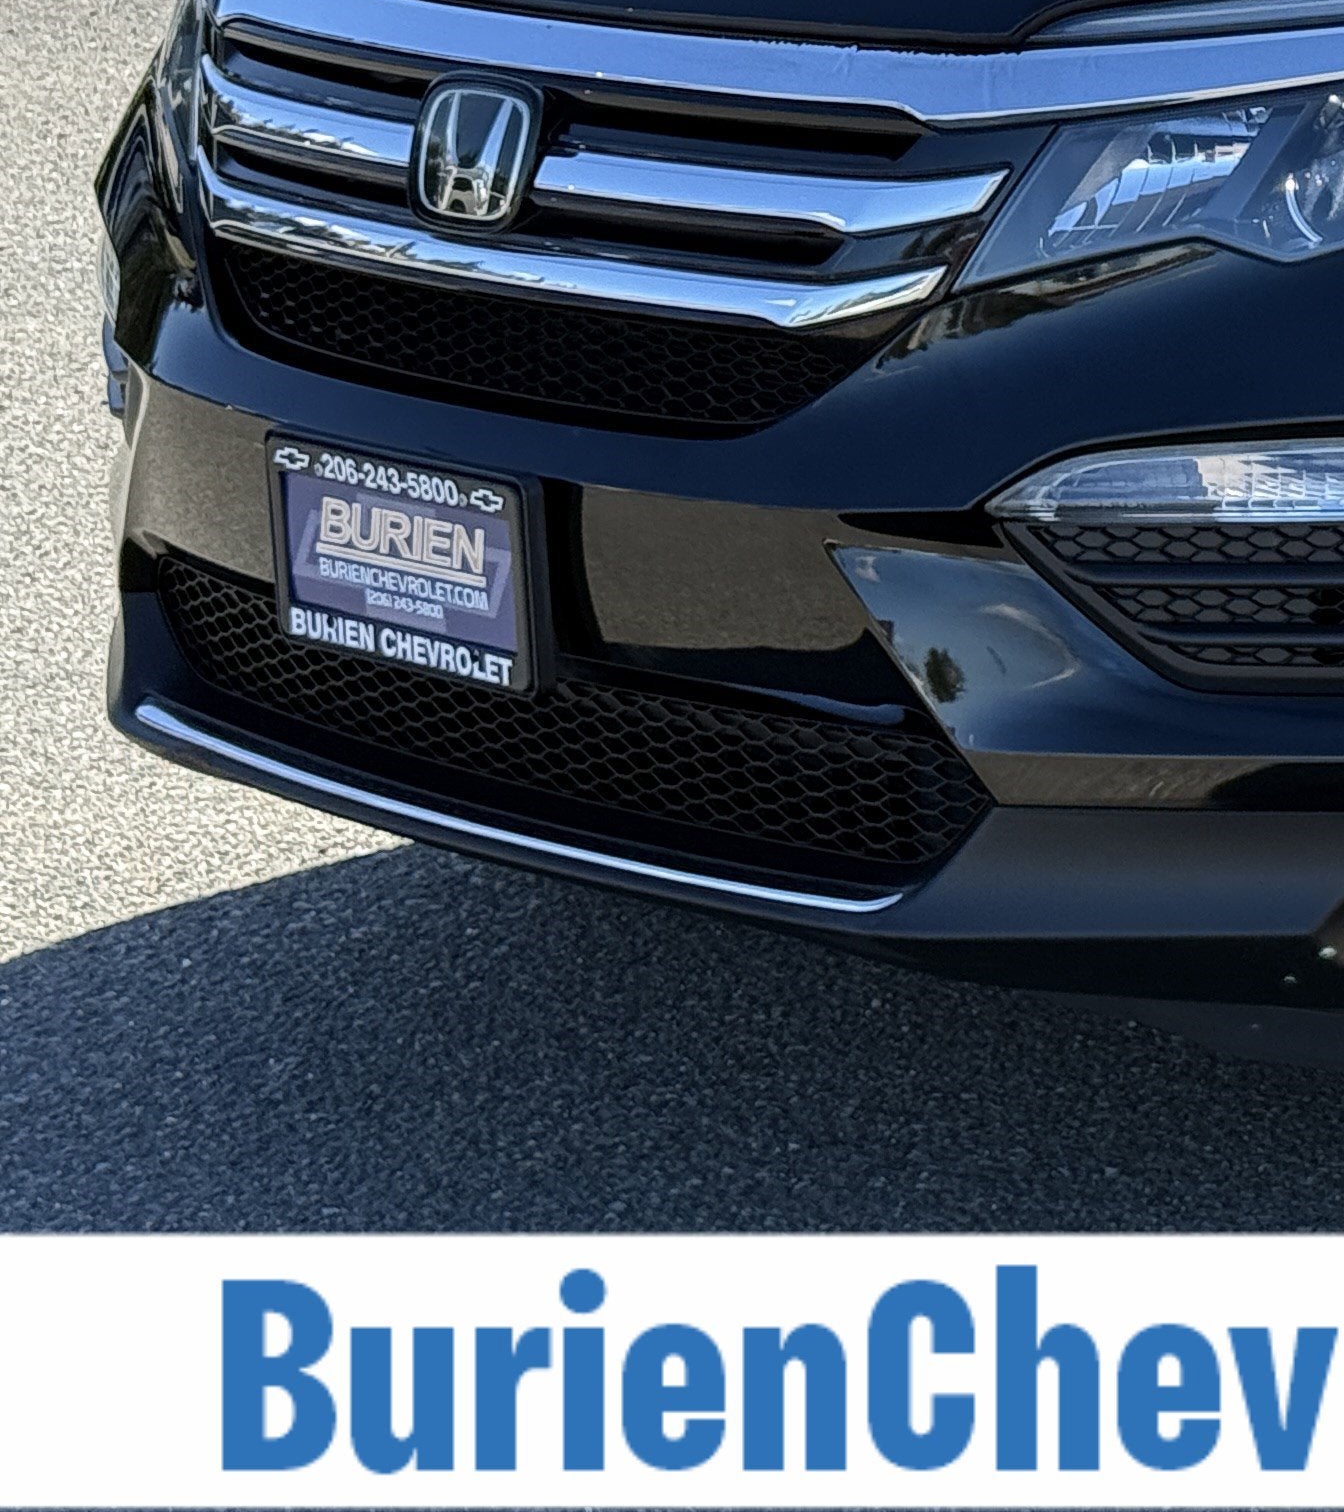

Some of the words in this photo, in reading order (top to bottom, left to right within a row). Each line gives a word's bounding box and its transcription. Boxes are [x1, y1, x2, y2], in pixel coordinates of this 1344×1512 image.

[319, 452, 459, 508] 206-243-5800
[320, 496, 485, 575] BURIEN
[318, 556, 489, 611] BURIENCHEVROLET.COM
